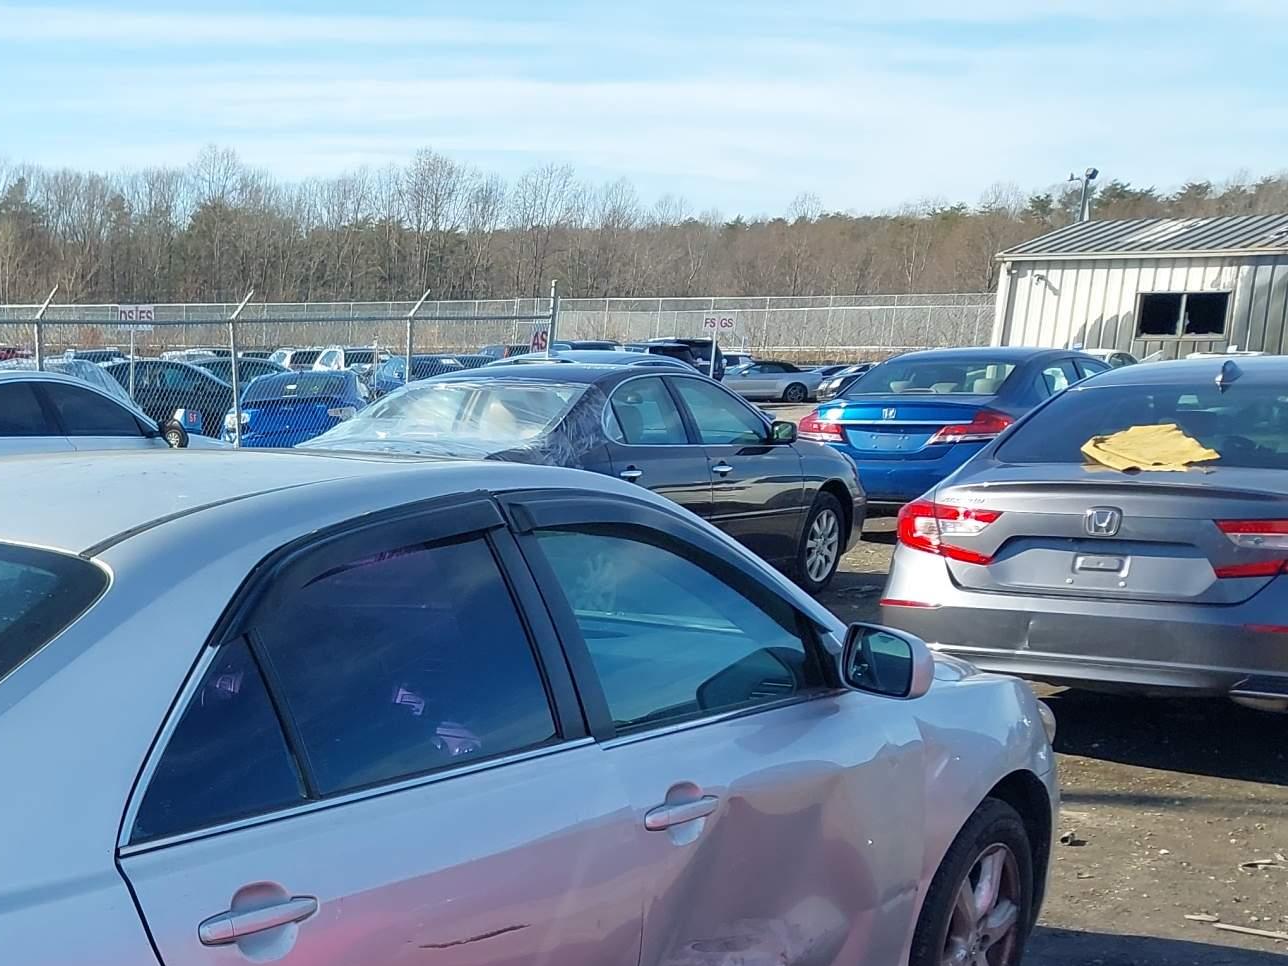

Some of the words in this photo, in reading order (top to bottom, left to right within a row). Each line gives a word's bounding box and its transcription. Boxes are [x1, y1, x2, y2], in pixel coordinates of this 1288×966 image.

[703, 317, 716, 328] FS
[720, 318, 734, 328] GS
[532, 330, 548, 351] AS
